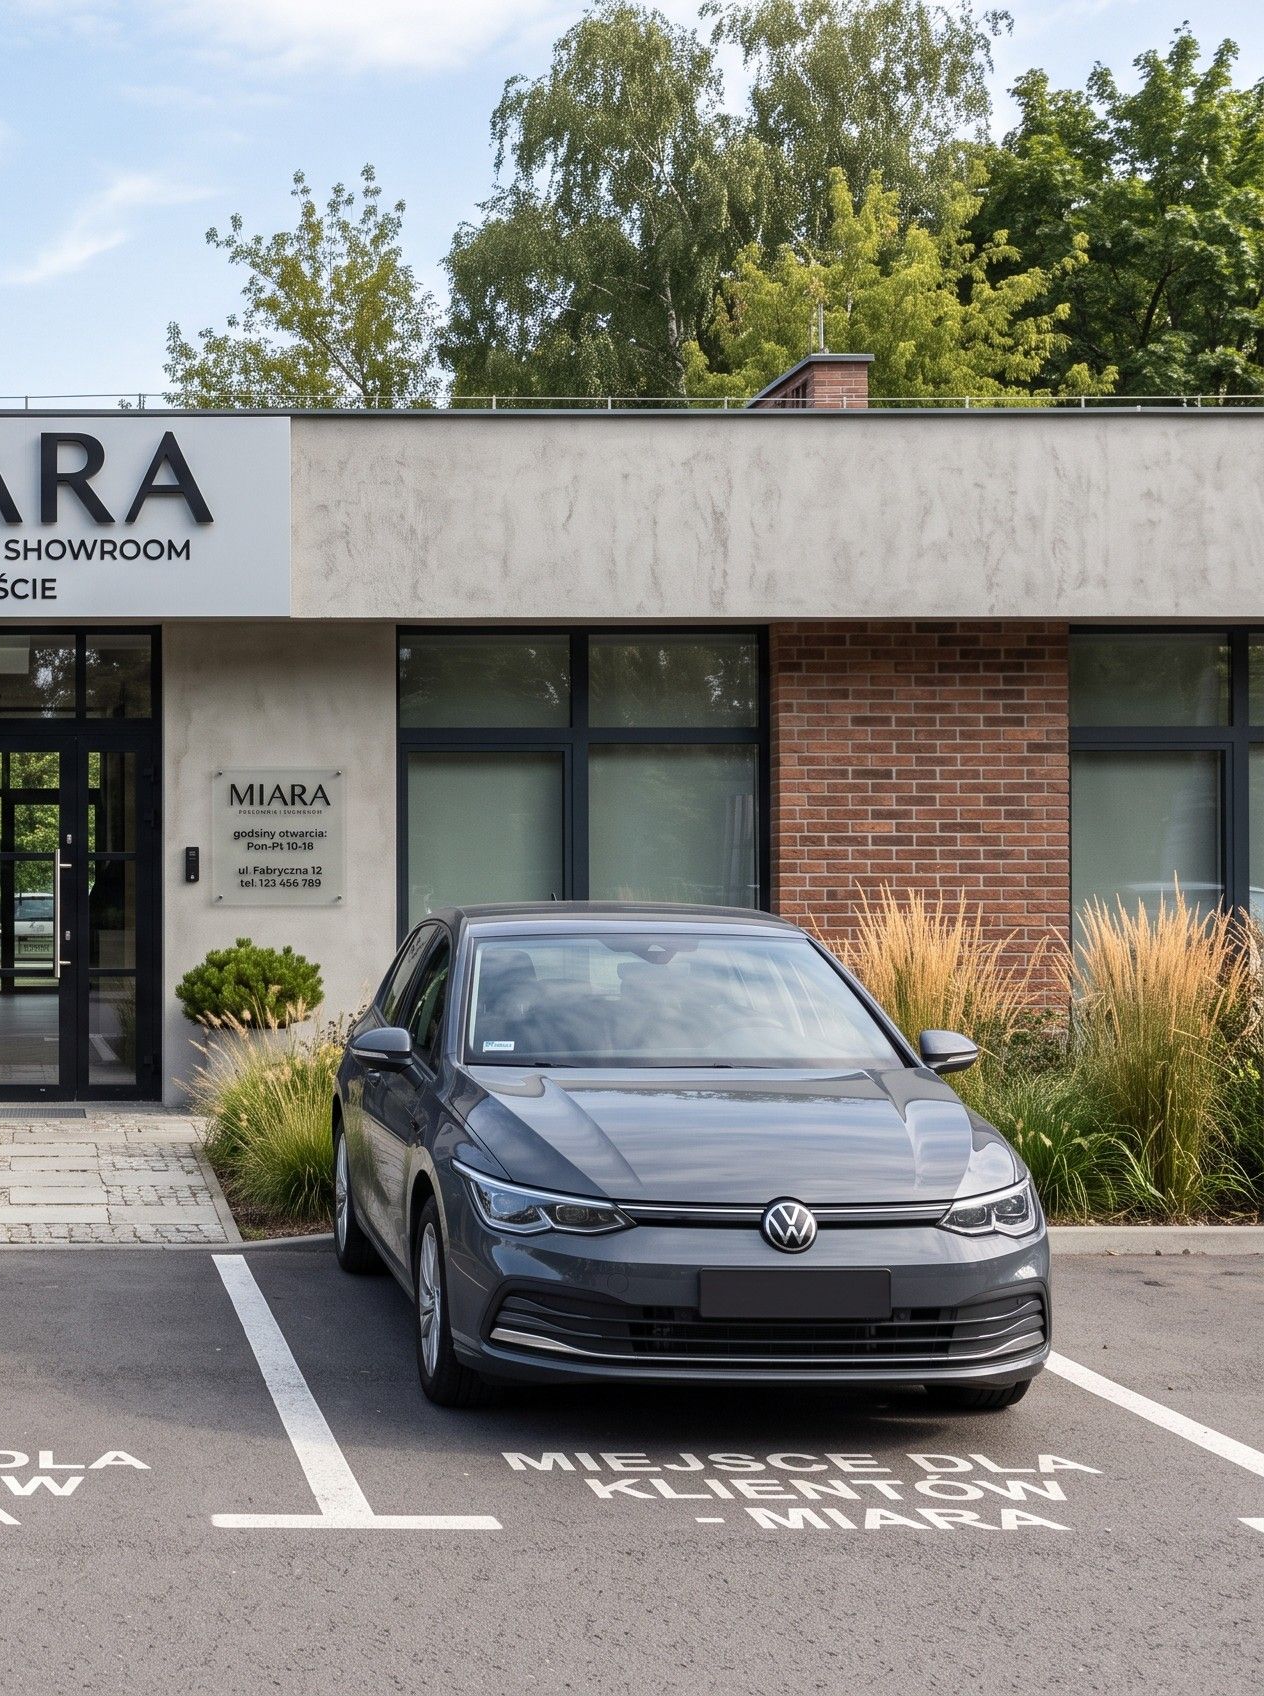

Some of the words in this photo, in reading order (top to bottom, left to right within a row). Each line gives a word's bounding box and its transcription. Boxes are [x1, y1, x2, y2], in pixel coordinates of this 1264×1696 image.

[4, 538, 191, 561] SHOWROOM
[230, 783, 331, 806] MIARA
[278, 828, 327, 839] otwarcia:
[247, 841, 284, 851] Pon-Pt
[253, 865, 308, 877] Fabryczna
[311, 865, 323, 875] 12
[240, 878, 257, 888] tel.
[259, 878, 276, 888] 123
[279, 878, 299, 888] 456
[302, 878, 322, 888] 789
[501, 1452, 893, 1473] MIEJSCE
[906, 1453, 1105, 1474] DLA
[583, 1474, 1068, 1501] KLIENTÓW
[743, 1507, 1073, 1531] MIARA
